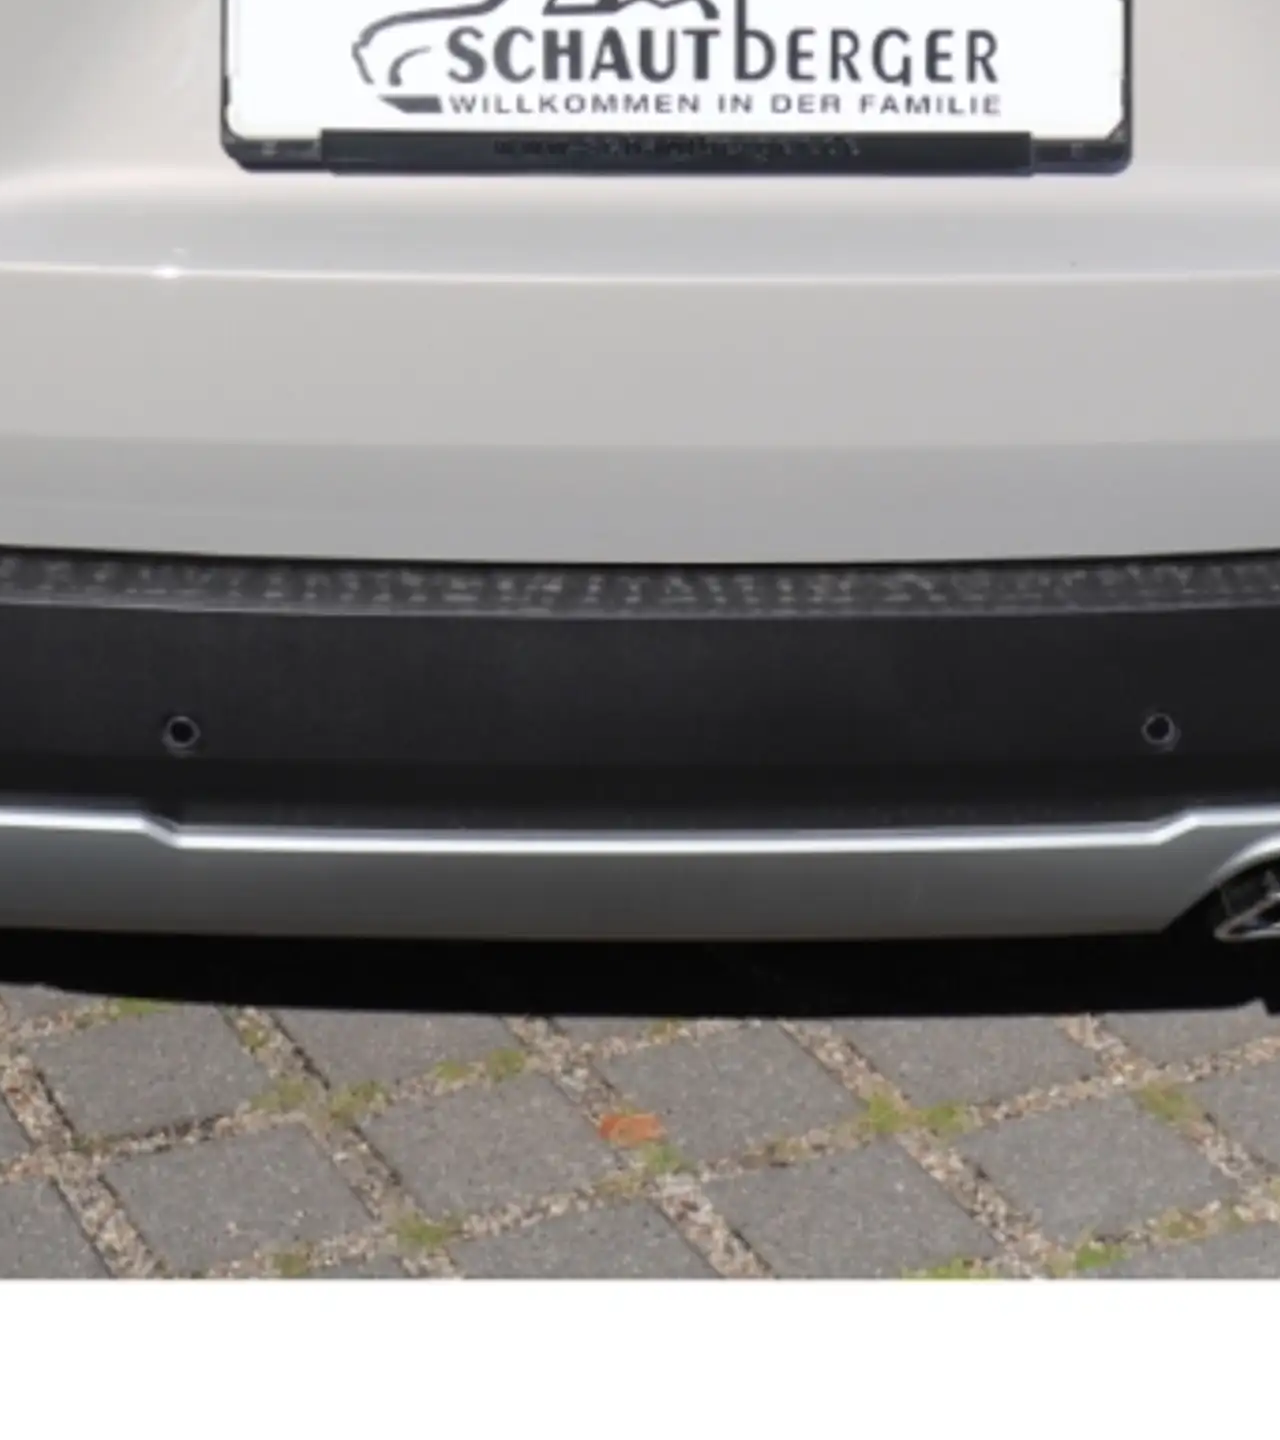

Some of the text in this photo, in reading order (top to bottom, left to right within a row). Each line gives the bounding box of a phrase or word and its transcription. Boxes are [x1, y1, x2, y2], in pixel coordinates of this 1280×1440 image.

[448, 93, 1001, 116] WILLKOMMEN IN DER FAMILIE
